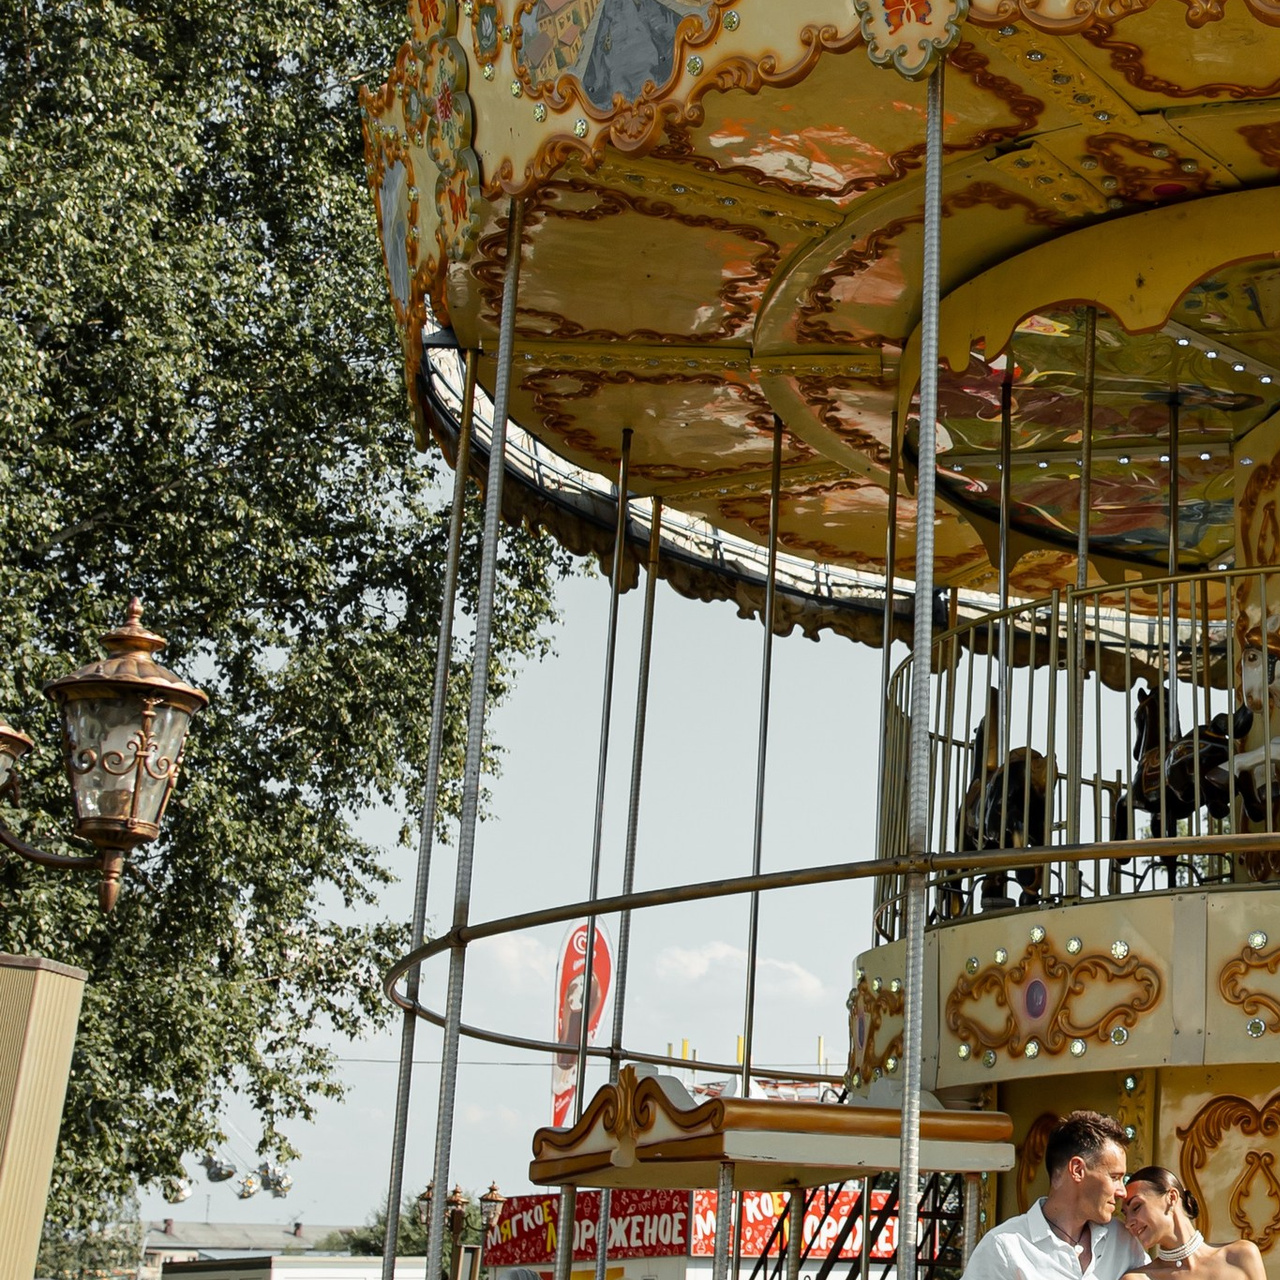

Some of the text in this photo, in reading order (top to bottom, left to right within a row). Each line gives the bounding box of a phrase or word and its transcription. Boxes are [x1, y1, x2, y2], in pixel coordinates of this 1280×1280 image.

[487, 1200, 552, 1250] МЯГКОЕ
[546, 1212, 686, 1253] ОРЖЕНОЕ
[695, 1191, 785, 1240] МКОЕ
